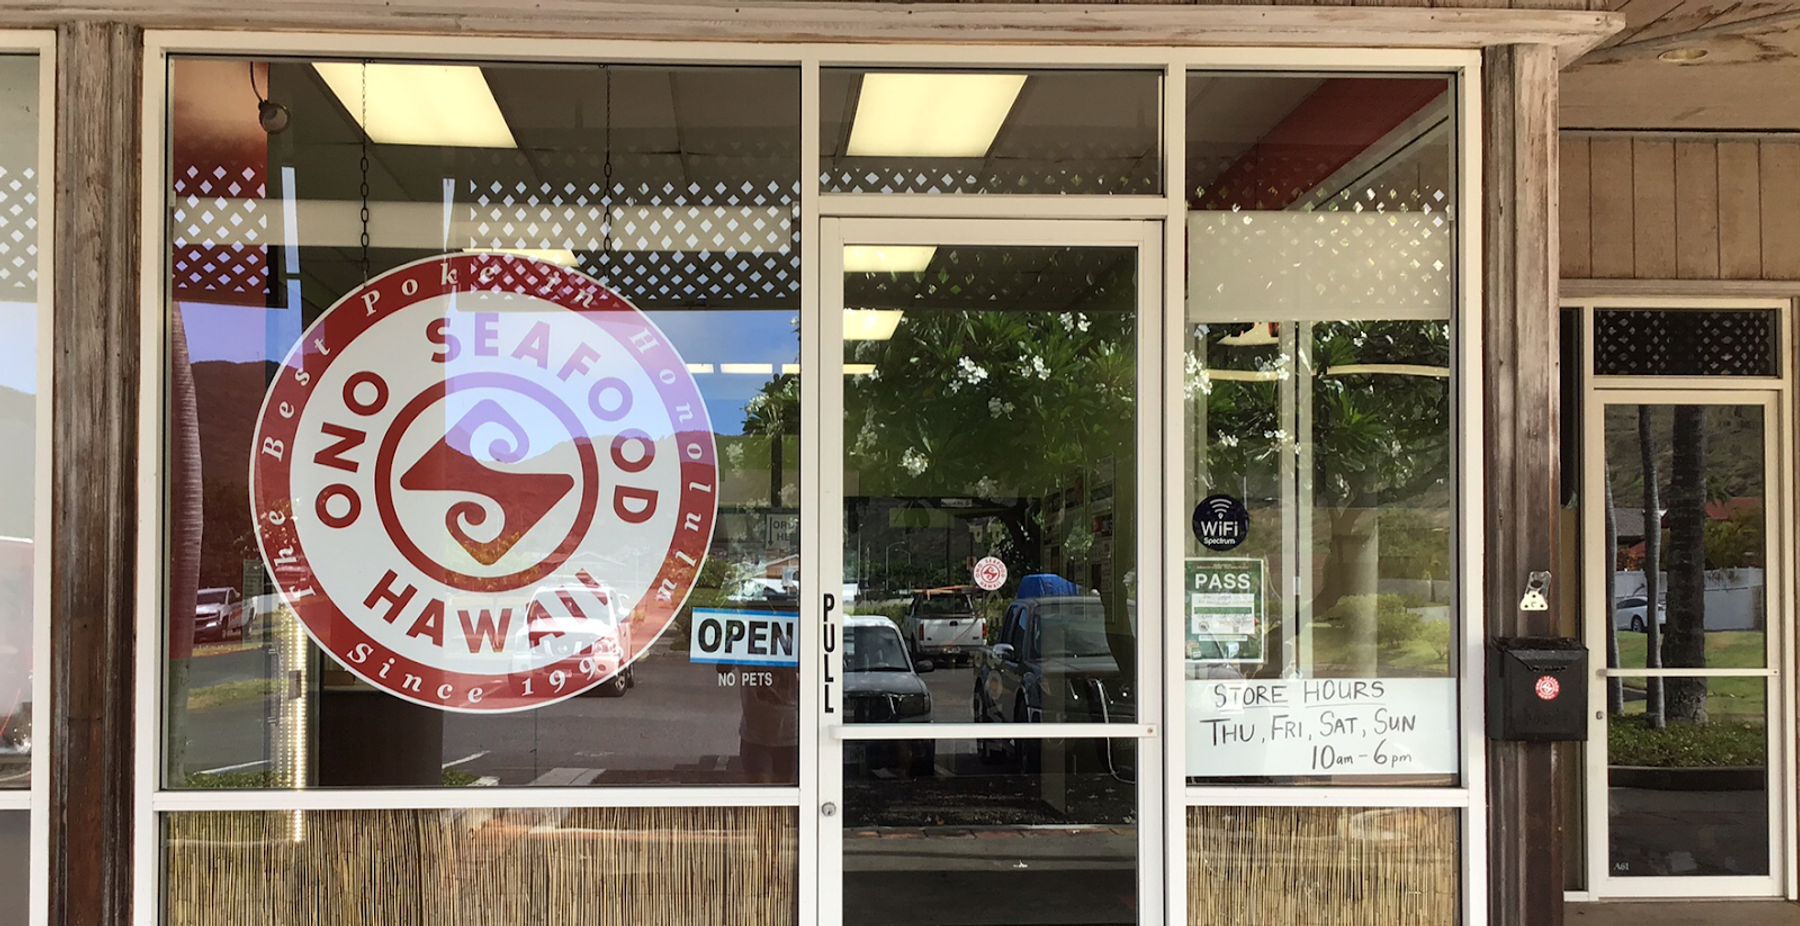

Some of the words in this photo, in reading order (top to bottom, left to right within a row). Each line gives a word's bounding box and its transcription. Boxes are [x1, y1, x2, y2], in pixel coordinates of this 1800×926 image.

[361, 263, 495, 317] Poke
[545, 271, 595, 308] in
[262, 337, 331, 462] Best
[425, 312, 660, 524] SEAFOOD
[313, 370, 389, 528] ONO
[629, 326, 712, 603] Honolulu
[268, 510, 316, 600] The
[1200, 520, 1239, 537] WiFi
[1203, 537, 1236, 546] Spectrum
[1195, 573, 1251, 590] PASS
[362, 568, 608, 653] HAWAII
[699, 618, 793, 657] OPEN
[346, 641, 484, 703] Since
[521, 640, 617, 697] 199
[718, 673, 736, 687] NO
[741, 672, 773, 687] PETS
[823, 593, 835, 714] PULL
[1214, 683, 1290, 708] STORE
[1304, 680, 1385, 701] HOURS
[1374, 708, 1417, 735] SUN
